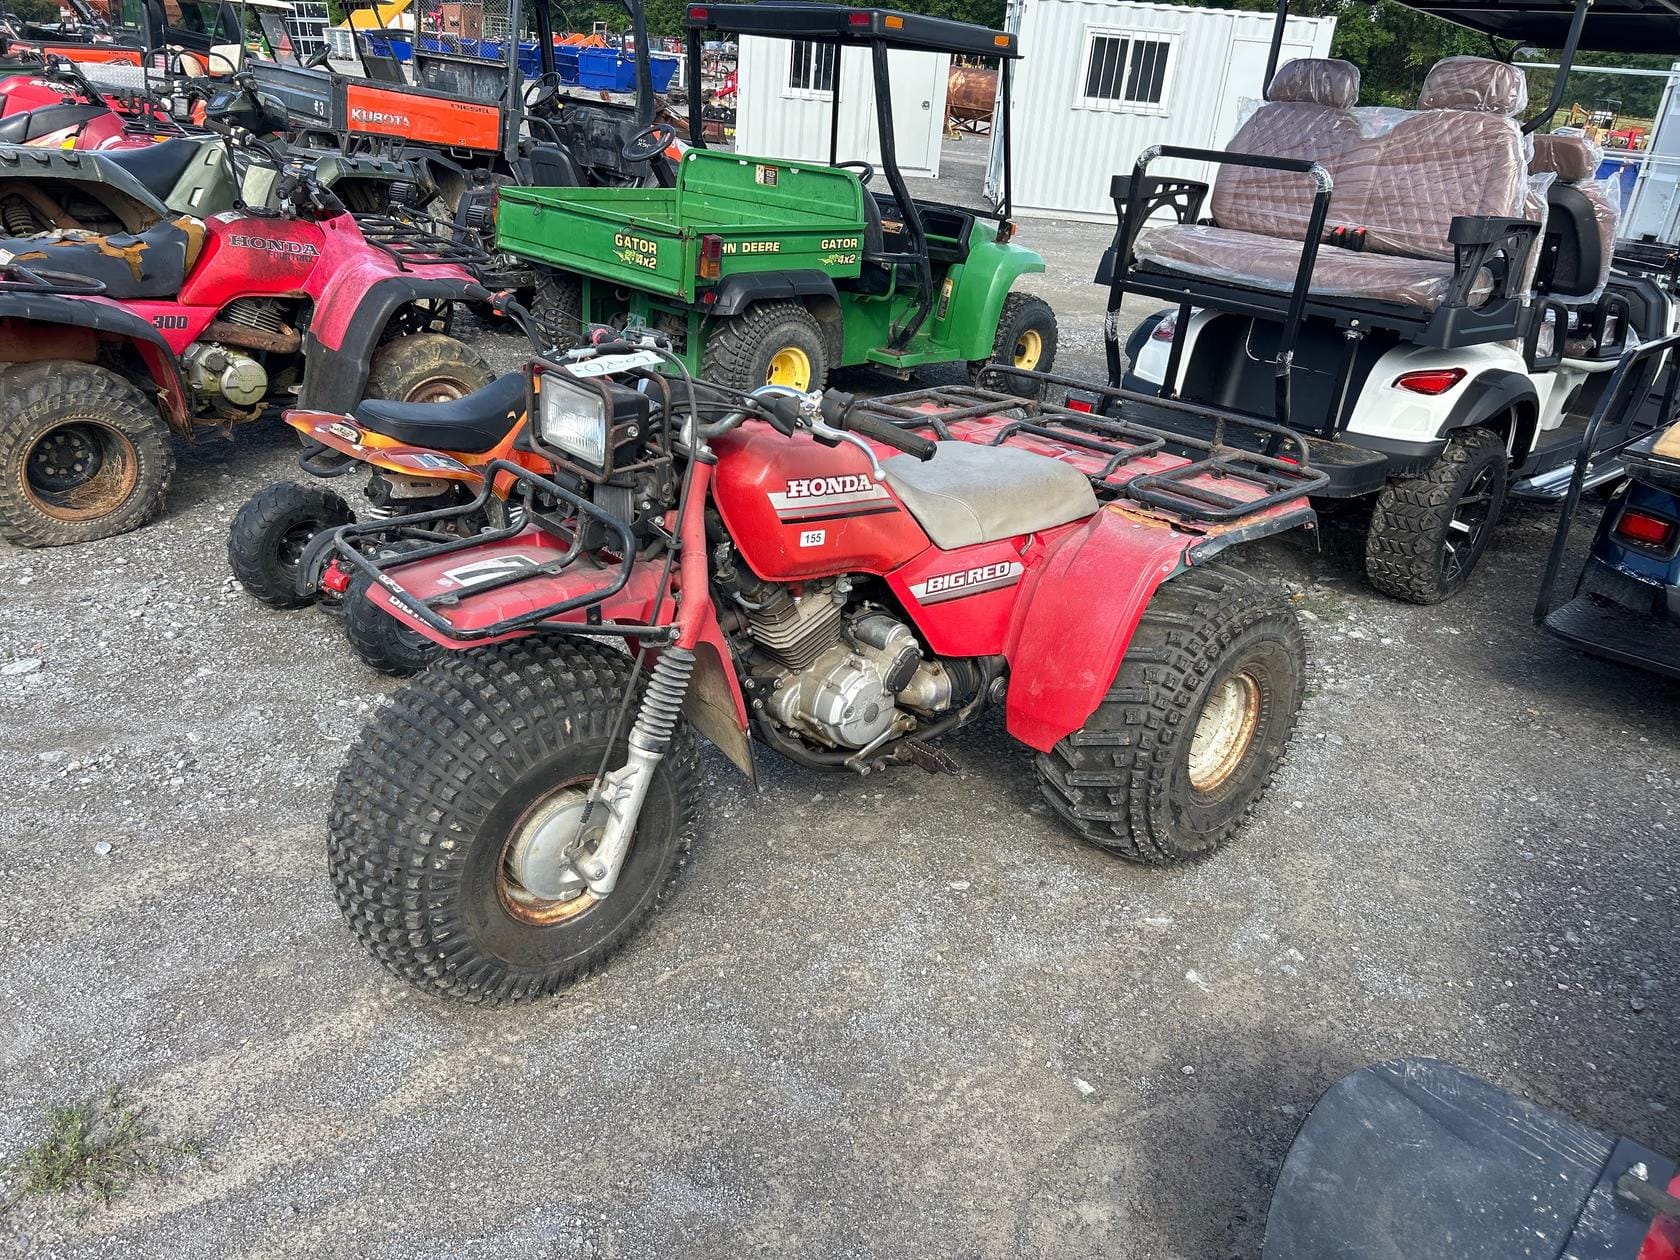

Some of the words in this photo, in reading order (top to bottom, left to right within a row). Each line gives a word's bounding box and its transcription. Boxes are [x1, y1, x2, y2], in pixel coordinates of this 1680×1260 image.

[450, 103, 492, 114] DIESEL
[351, 108, 411, 127] KUBOTA
[229, 234, 320, 257] HONDA
[614, 233, 657, 255] GATOR
[721, 242, 738, 254] HN
[742, 241, 781, 253] DEERE
[821, 238, 858, 250] GATOR
[636, 254, 657, 269] 4x2
[837, 254, 857, 265] 4x2
[153, 315, 188, 329] 300
[786, 474, 874, 498] HONDA
[805, 533, 822, 544] 155
